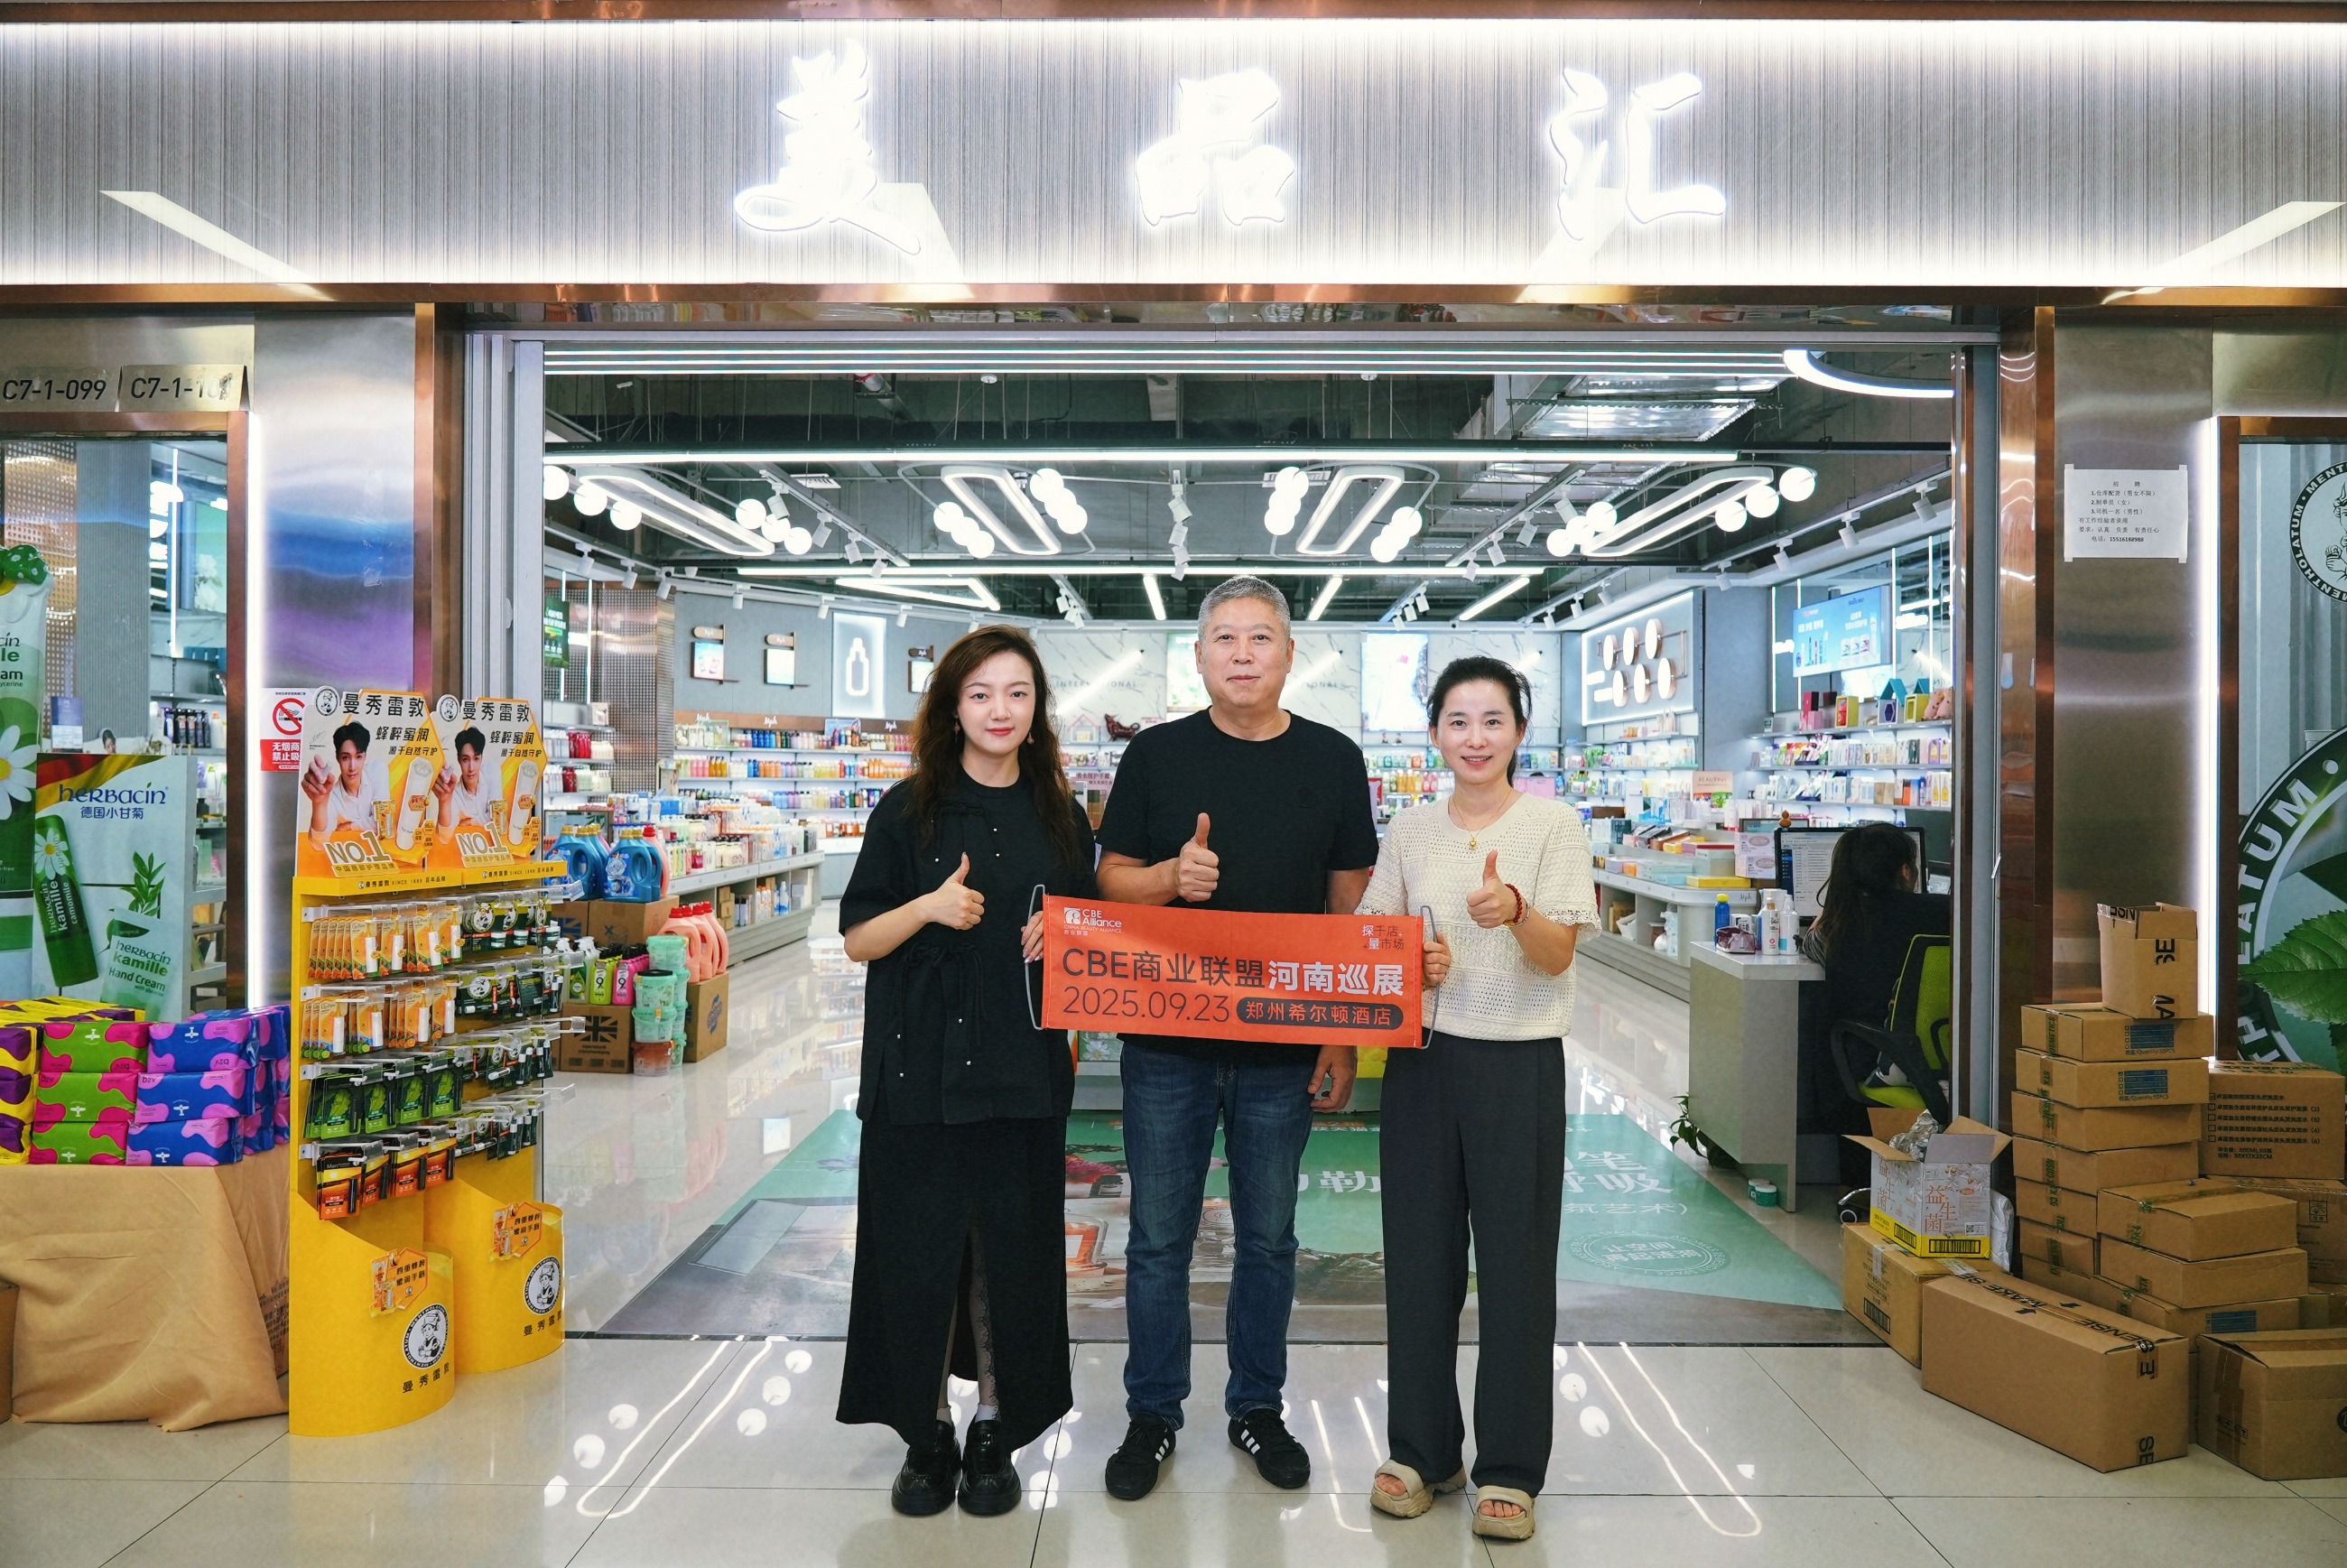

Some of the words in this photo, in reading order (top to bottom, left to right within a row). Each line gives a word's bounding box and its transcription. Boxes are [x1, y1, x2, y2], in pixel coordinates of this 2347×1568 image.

[735, 42, 1726, 255] 美品汇
[2, 379, 107, 400] C7-1-099
[2305, 463, 2347, 495] MENT
[343, 694, 424, 717] 曼秀雷敦
[462, 701, 530, 722] 曼秀雷敦
[388, 746, 438, 757] 源于自然守护
[500, 748, 543, 758] 源于自然守护
[80, 806, 144, 820] 德国小甘菊
[326, 831, 391, 863] NO.1
[458, 822, 508, 855] NO.1
[55, 880, 69, 932] kamille
[1082, 909, 1102, 918] CBE
[1082, 917, 1122, 928] Alliance
[1361, 924, 1398, 937] 探千店
[1368, 938, 1405, 950] 量市场
[113, 950, 169, 977] kamille
[108, 967, 135, 982] Hand
[135, 974, 166, 992] Cream
[1062, 986, 1230, 1022] 2025.09.23
[1245, 1000, 1392, 1026] 郑州希尔顿酒店
